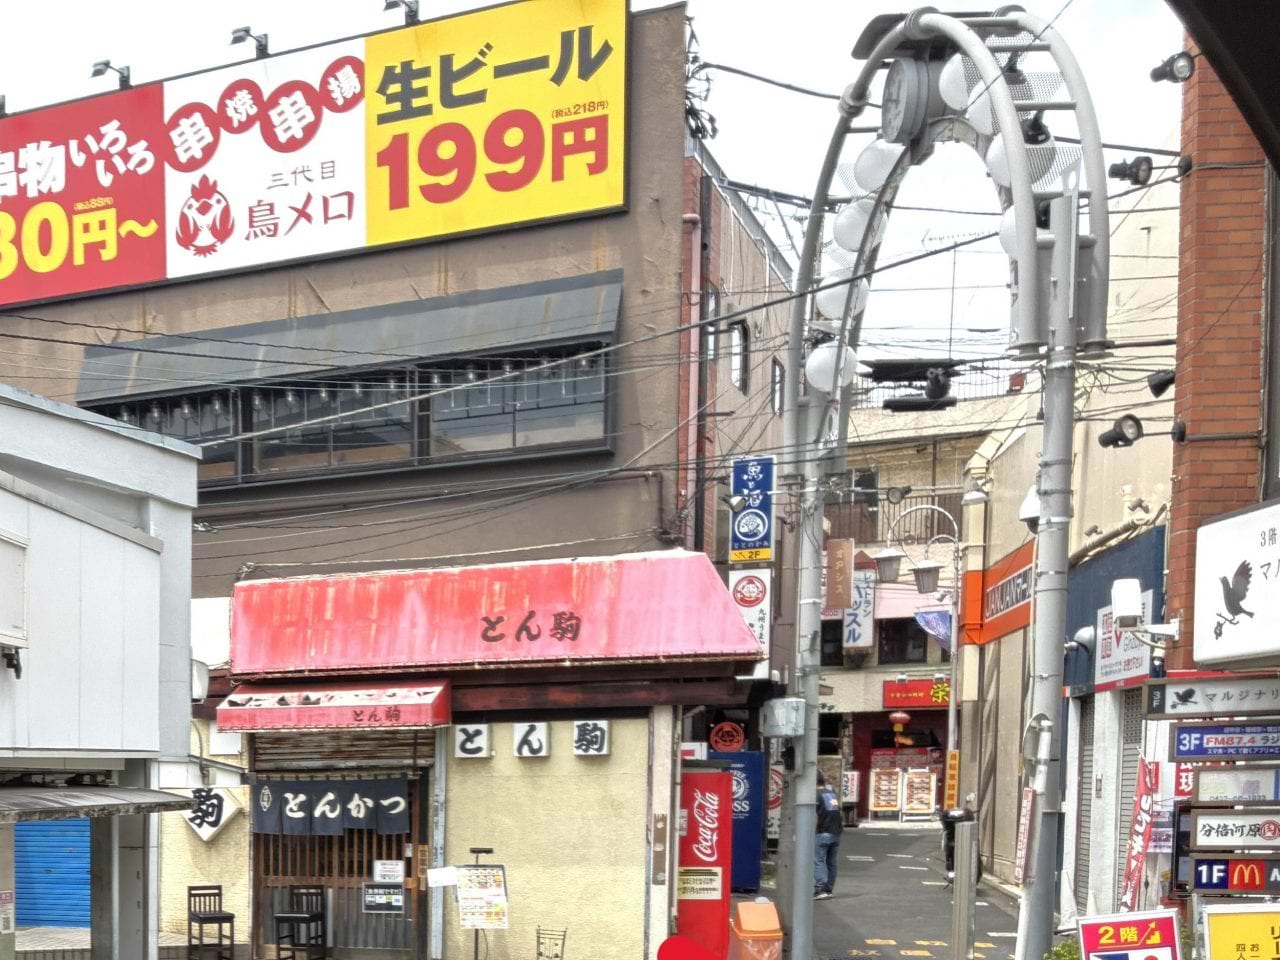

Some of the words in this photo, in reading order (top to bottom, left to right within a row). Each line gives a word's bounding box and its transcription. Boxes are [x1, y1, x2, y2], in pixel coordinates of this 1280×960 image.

[375, 24, 614, 126] 生ビール
[376, 107, 610, 211] 199円
[268, 160, 337, 189] 三代目
[243, 189, 356, 241] 鳥メロ
[748, 550, 761, 559] 2F
[863, 573, 872, 618] レストラン
[480, 610, 583, 643] とん駒
[352, 706, 402, 723] とん駒
[458, 721, 608, 757] とん駒
[1179, 733, 1201, 751] 3F
[1205, 736, 1257, 747] FM87.4
[283, 791, 407, 819] とんかつ
[732, 800, 750, 812] SS
[693, 788, 719, 862] Coca-Cola
[1200, 823, 1261, 838] 分倍河原
[1198, 864, 1226, 884] 1F
[1098, 925, 1138, 944] 2階
